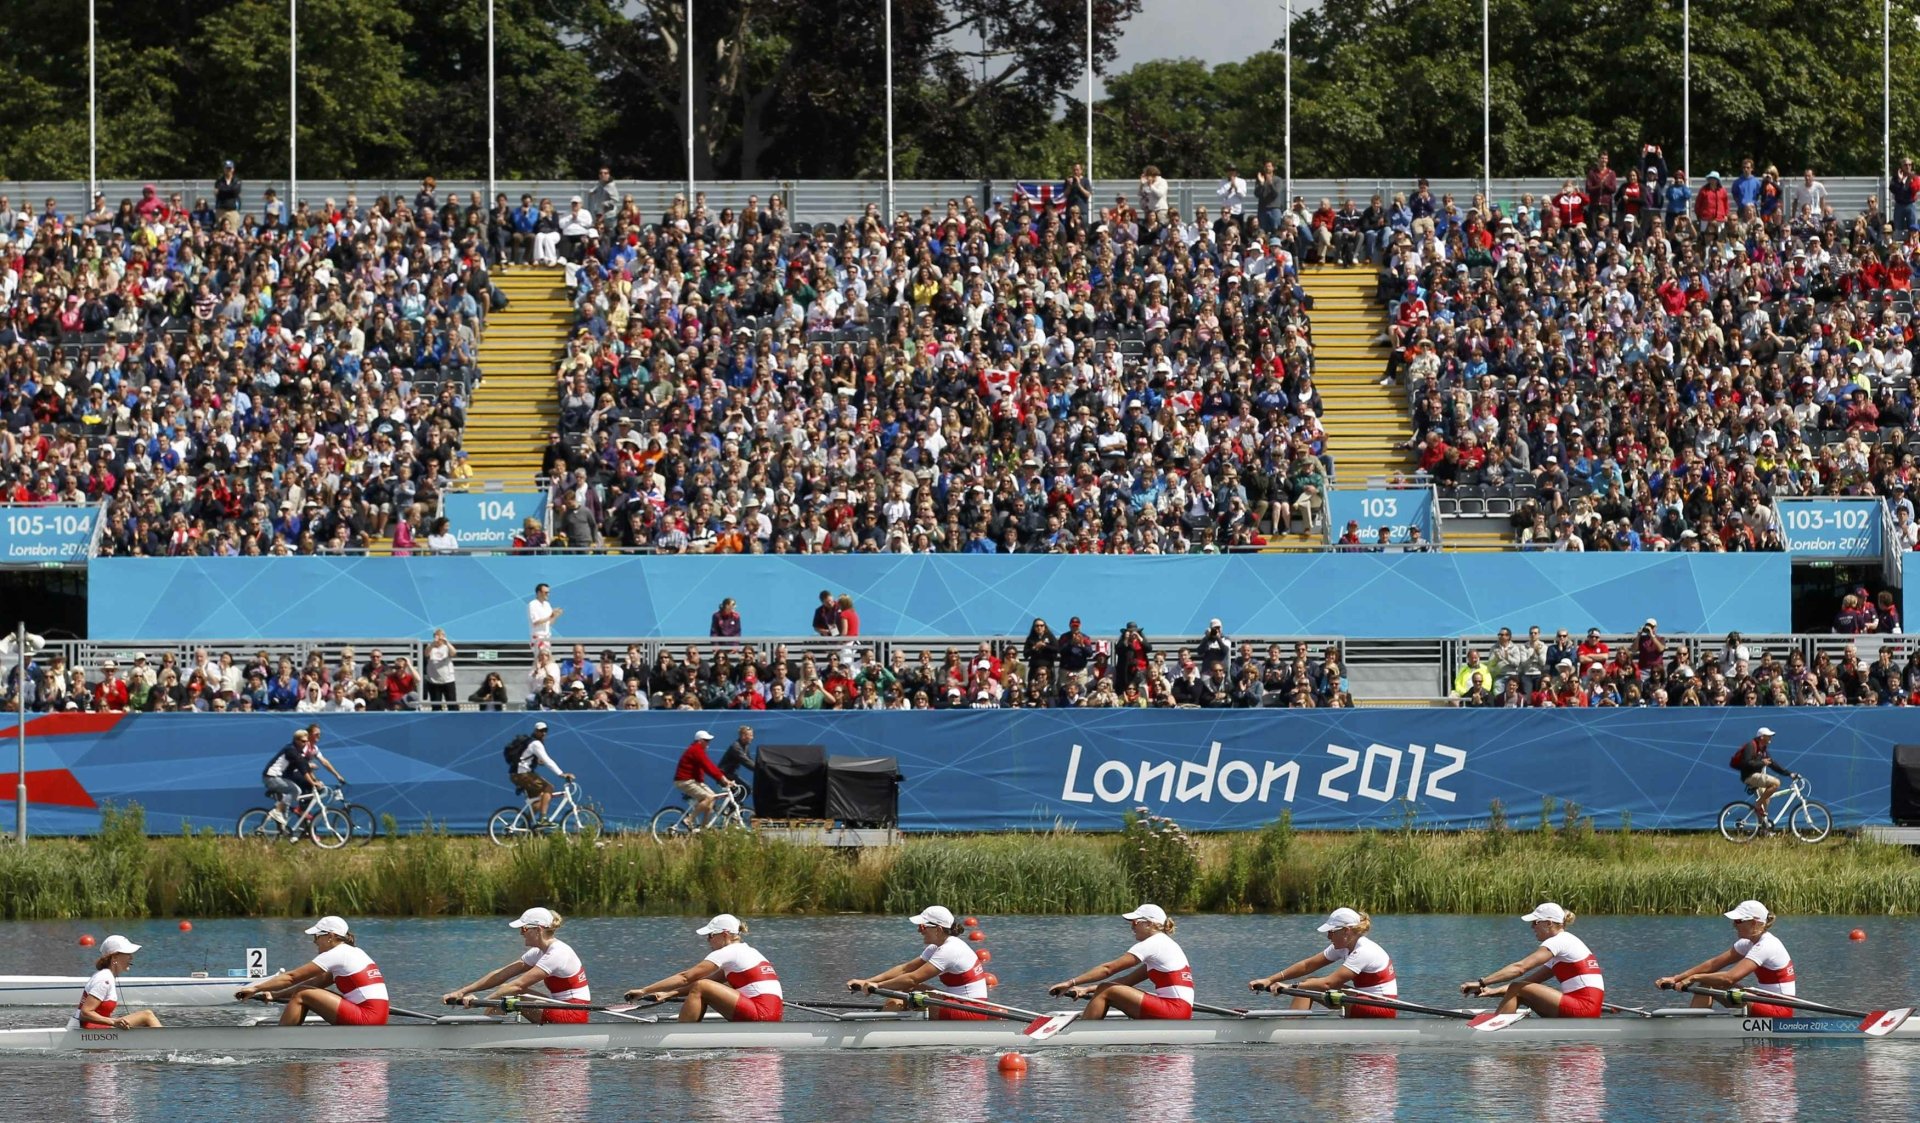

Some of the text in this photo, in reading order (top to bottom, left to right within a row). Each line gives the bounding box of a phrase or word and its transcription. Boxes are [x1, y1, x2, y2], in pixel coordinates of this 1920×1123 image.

[478, 501, 516, 521] 104
[1360, 498, 1397, 518] 103
[7, 516, 90, 535] 105-104
[1786, 510, 1869, 530] 103-102
[456, 528, 504, 542] London
[1788, 536, 1870, 551] London 2012
[9, 542, 57, 556] London
[1062, 741, 1467, 803] London 2012
[251, 950, 263, 968] 2
[1742, 1019, 1829, 1031] CAN London 2012
[81, 1033, 119, 1041] HUDSON
